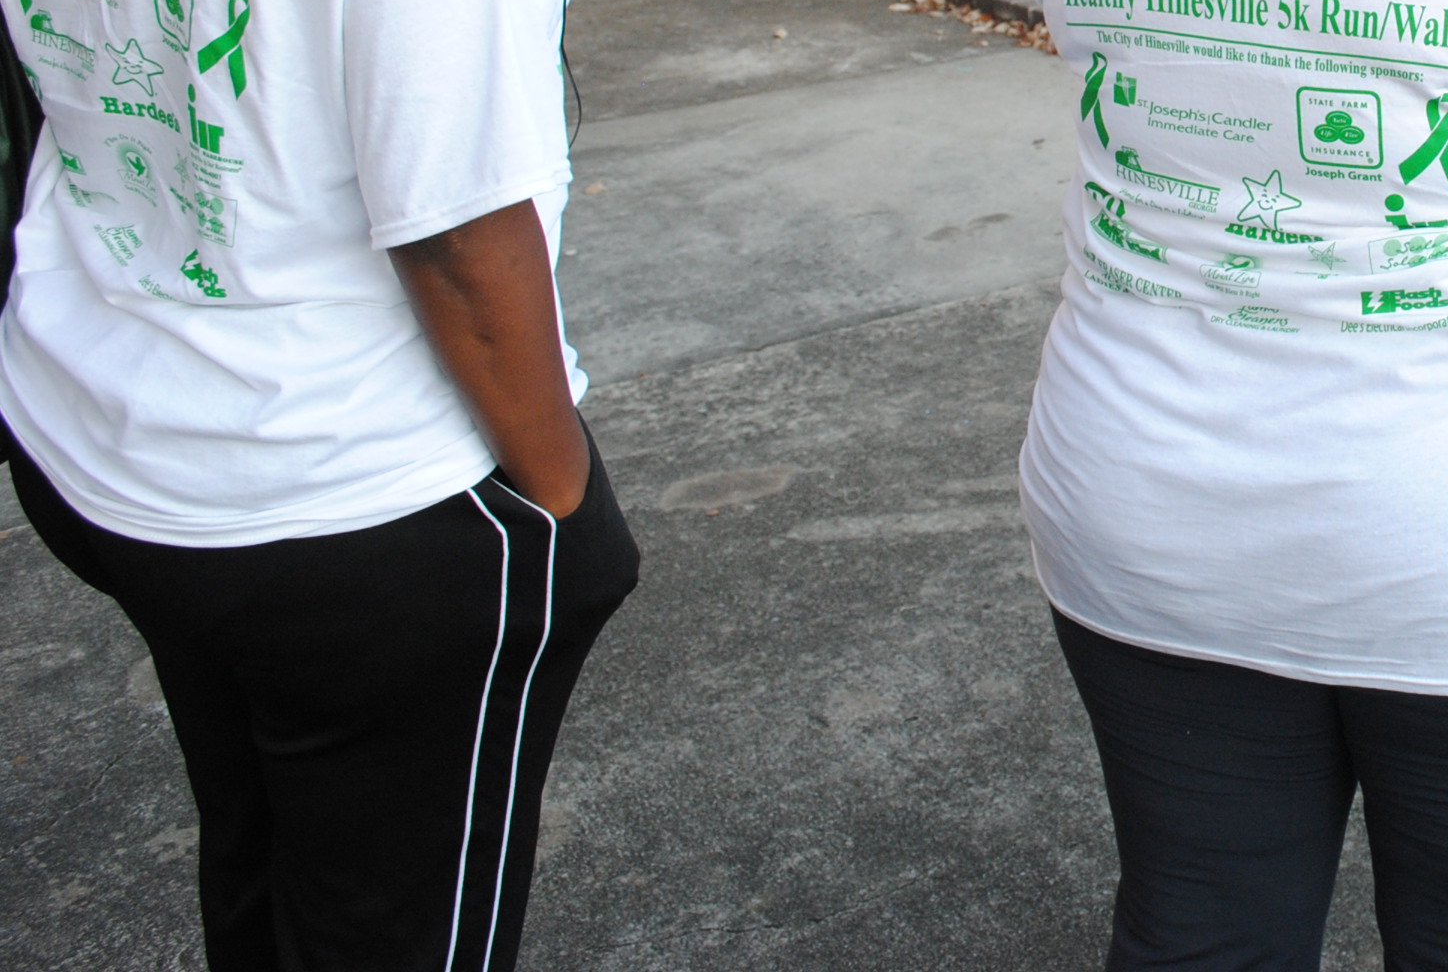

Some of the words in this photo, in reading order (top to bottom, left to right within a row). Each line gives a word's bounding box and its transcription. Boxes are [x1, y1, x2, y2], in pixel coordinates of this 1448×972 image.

[1096, 29, 1112, 44] The
[1114, 32, 1132, 49] City
[1134, 34, 1144, 46] of
[1145, 34, 1190, 54] Hinesville
[1192, 45, 1223, 60] would
[1225, 47, 1245, 62] like
[1247, 51, 1257, 64] to
[1260, 51, 1292, 68] thank
[1294, 54, 1312, 71] the
[1314, 57, 1367, 78] following
[1369, 65, 1424, 83] sponsors:
[1308, 97, 1334, 107] STATE
[1341, 100, 1368, 109] FARM
[1136, 98, 1149, 109] ST.
[1149, 101, 1206, 122] Joseph's
[1211, 112, 1273, 132] Candler
[1147, 116, 1219, 139] Immediate
[1223, 129, 1255, 144] Care
[1310, 146, 1371, 158] INSURANCE
[1305, 167, 1345, 181] Joseph
[1348, 170, 1383, 182] Grant
[1116, 164, 1220, 207] HINESVILLE
[1188, 201, 1218, 214] GEORGIA
[1202, 267, 1234, 281] Mount
[1210, 314, 1225, 324] DRY
[1225, 318, 1260, 332] CLEANING
